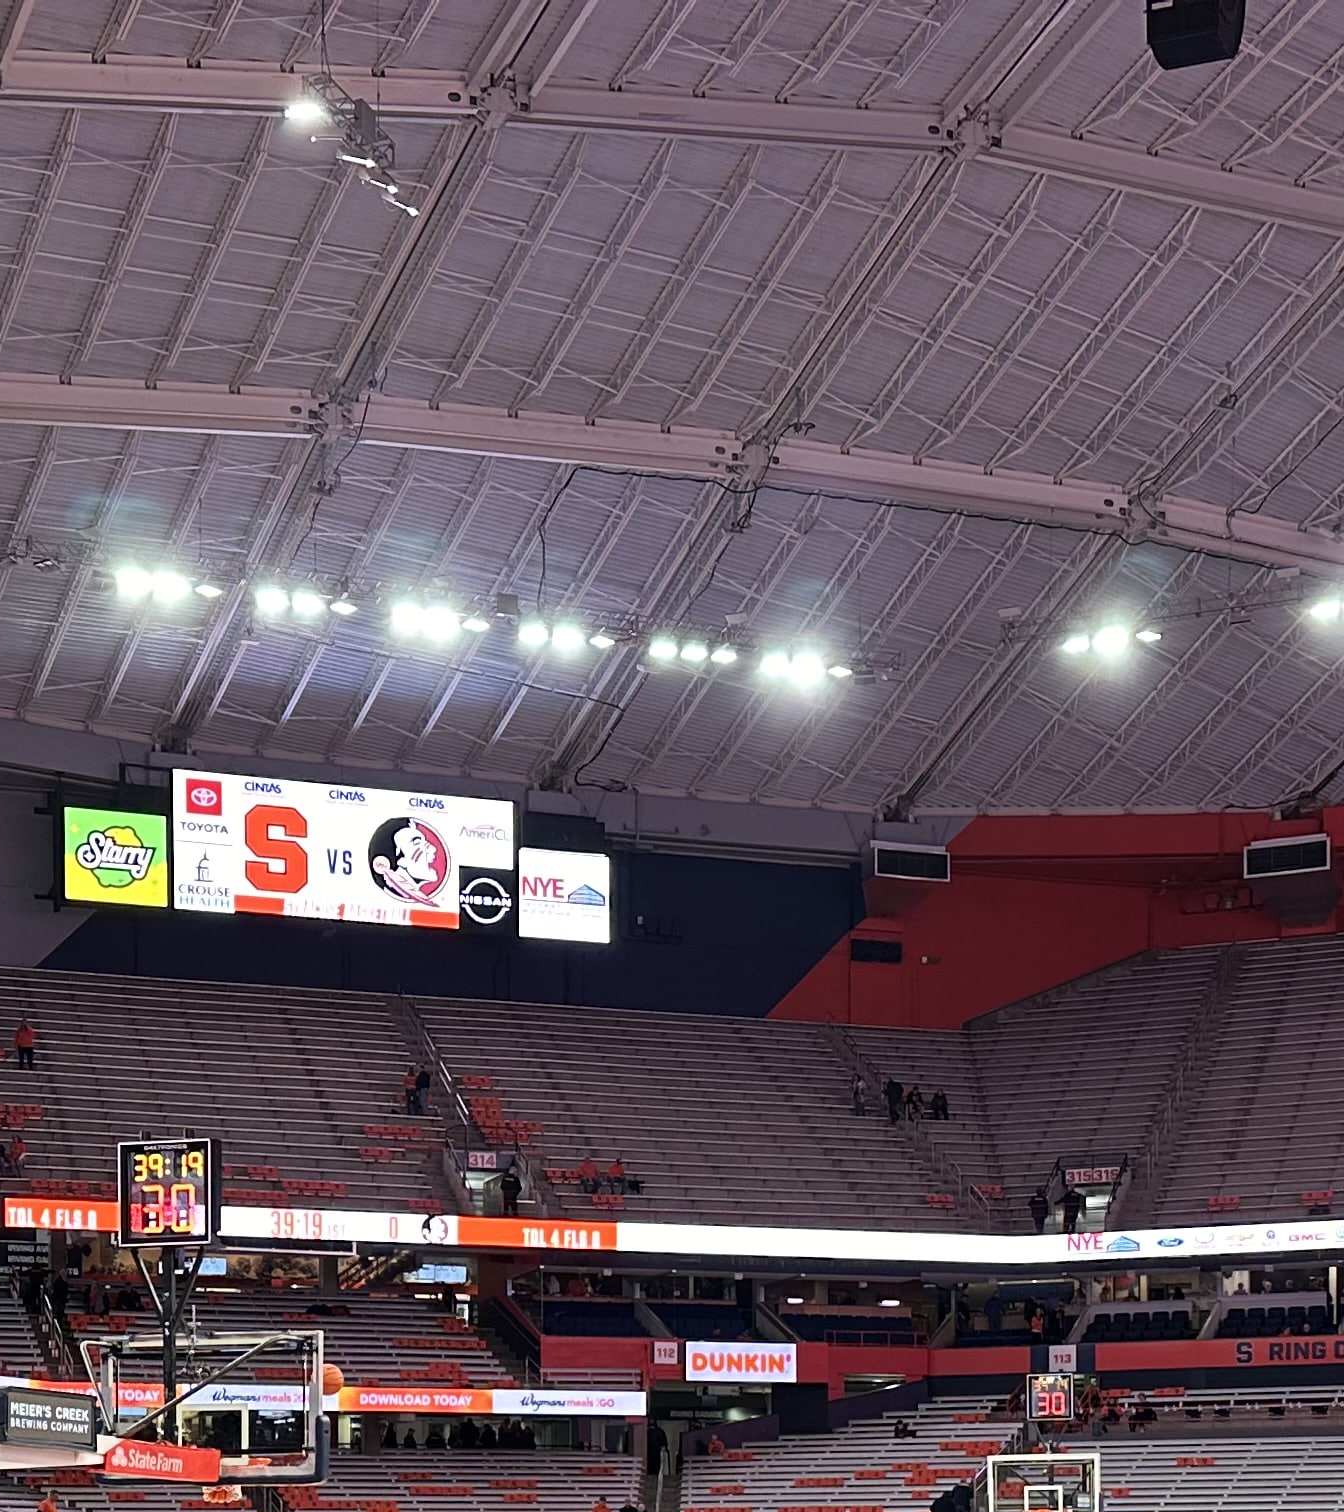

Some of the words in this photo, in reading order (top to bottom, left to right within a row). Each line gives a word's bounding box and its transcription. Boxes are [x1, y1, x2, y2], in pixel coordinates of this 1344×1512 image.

[244, 780, 282, 795] CINTAS
[329, 789, 366, 803] CINTAS
[408, 796, 445, 811] CINTAS
[180, 821, 229, 835] TOYOTA
[76, 830, 155, 880] Starry
[244, 804, 308, 894] S
[327, 848, 353, 876] VS
[178, 882, 231, 899] CROUSE
[522, 876, 564, 899] NYE
[178, 896, 230, 909] HEALTH
[459, 894, 512, 908] NISSAN
[133, 1152, 204, 1182] 39:19
[468, 1153, 496, 1169] 314
[39, 1207, 50, 1228] 4
[56, 1208, 82, 1229] FLS
[271, 1211, 323, 1240] 39:19
[389, 1216, 398, 1240] 0
[1067, 1232, 1104, 1252] NYE
[1289, 1232, 1327, 1242] GMC
[656, 1347, 676, 1359] 112
[1054, 1354, 1072, 1364] 113
[1236, 1341, 1253, 1363] S
[1269, 1341, 1327, 1361] RING
[691, 1352, 791, 1374] DUNKIN'
[10, 1401, 52, 1418] MEIER'S
[55, 1406, 90, 1422] CREEK
[359, 1392, 432, 1407] DOWNLOAD
[434, 1393, 473, 1408] TODAY
[520, 1394, 566, 1412] Wegmans
[1037, 1391, 1066, 1417] 30
[10, 1417, 49, 1431] BREWING
[50, 1421, 89, 1435] COMPANY
[127, 1449, 157, 1468] State
[157, 1452, 183, 1474] Farm
